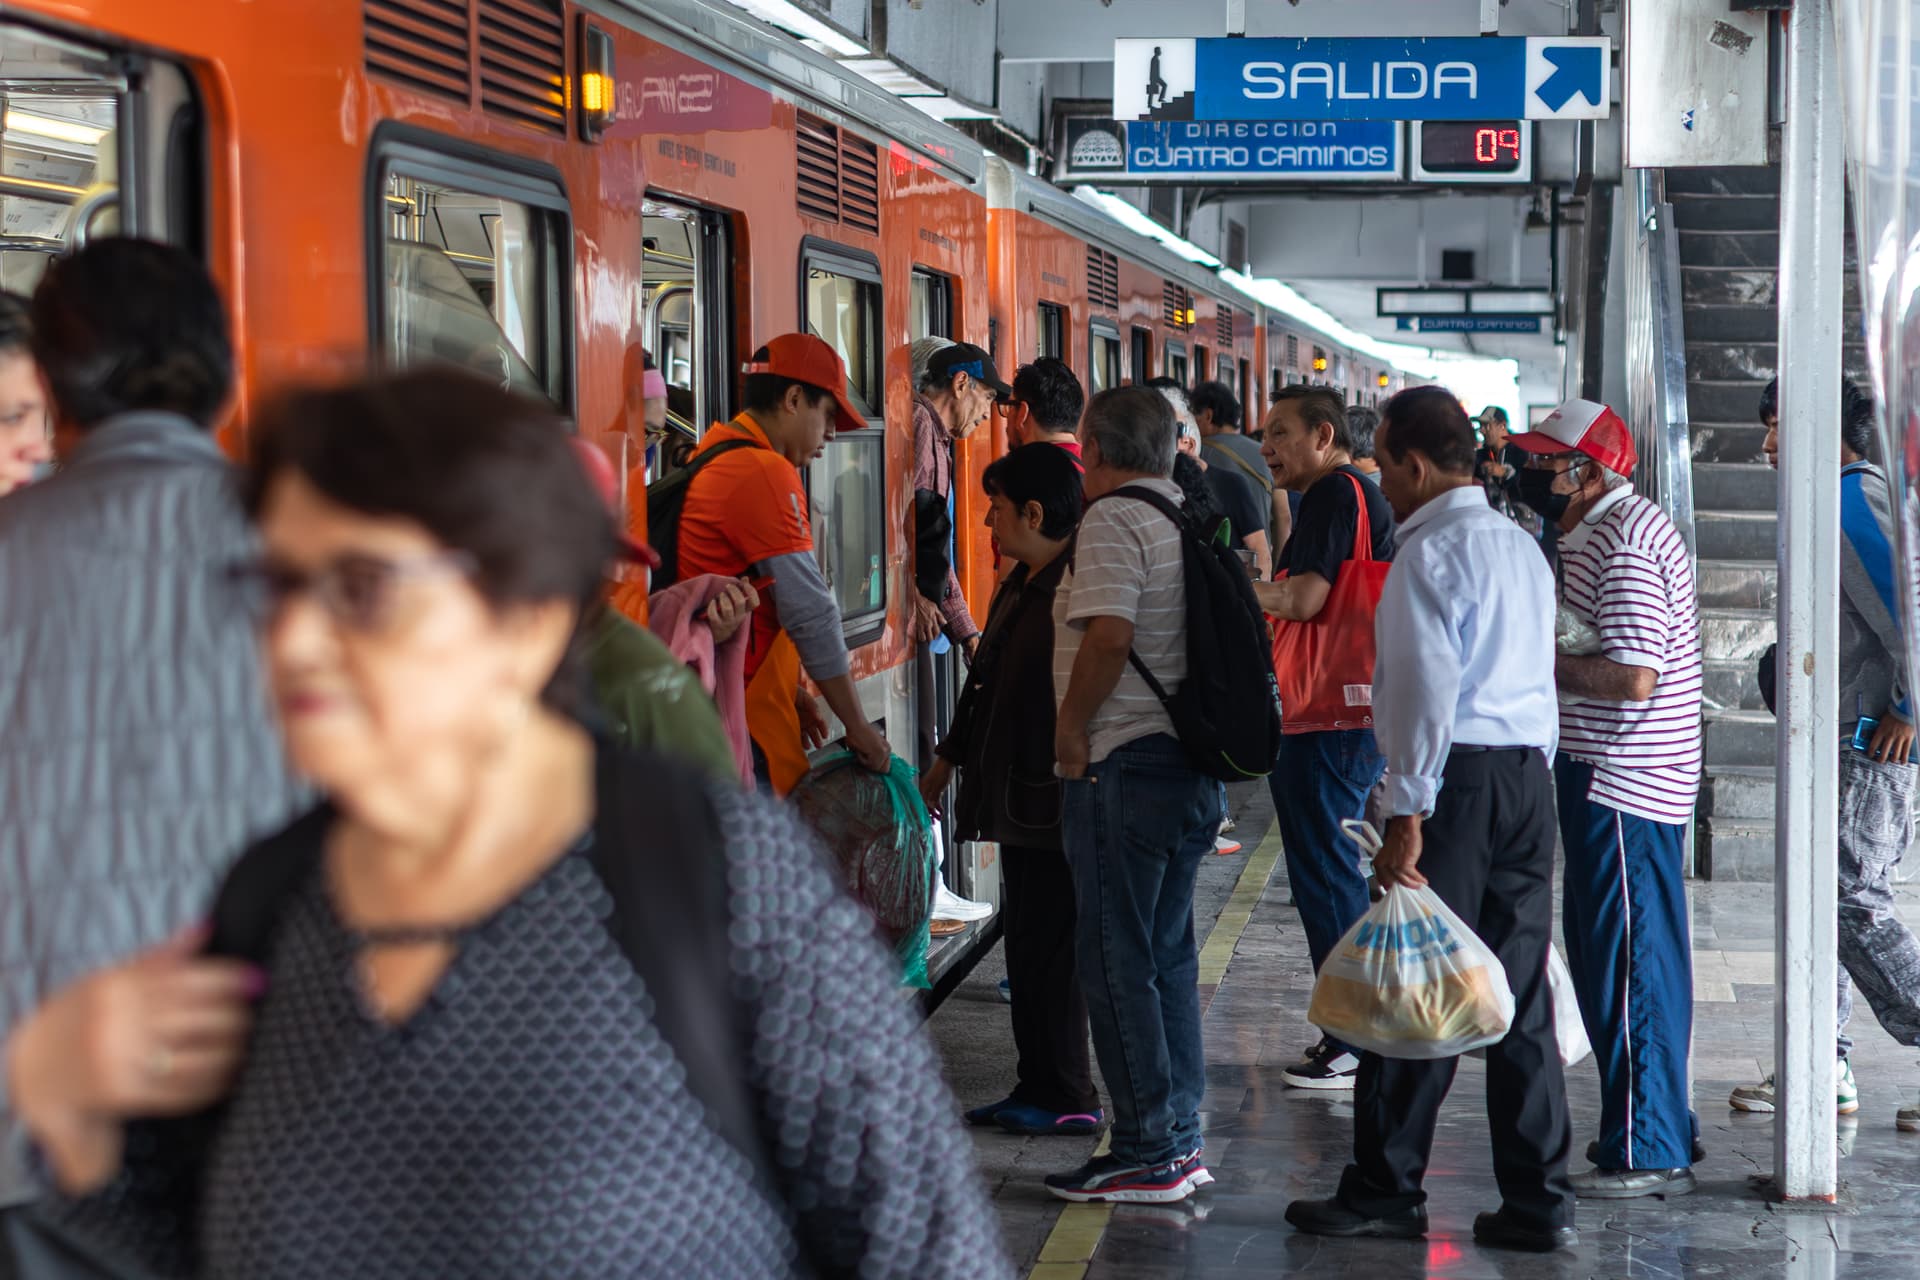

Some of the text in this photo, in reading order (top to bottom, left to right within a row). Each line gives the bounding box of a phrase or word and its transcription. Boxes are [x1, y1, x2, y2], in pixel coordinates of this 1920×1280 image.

[1242, 60, 1478, 100] SALIDA
[1186, 122, 1337, 138] DIRECCION
[1476, 128, 1520, 162] 09
[1134, 146, 1388, 167] CUATRO CAMINOS
[1422, 318, 1474, 330] CUATRO
